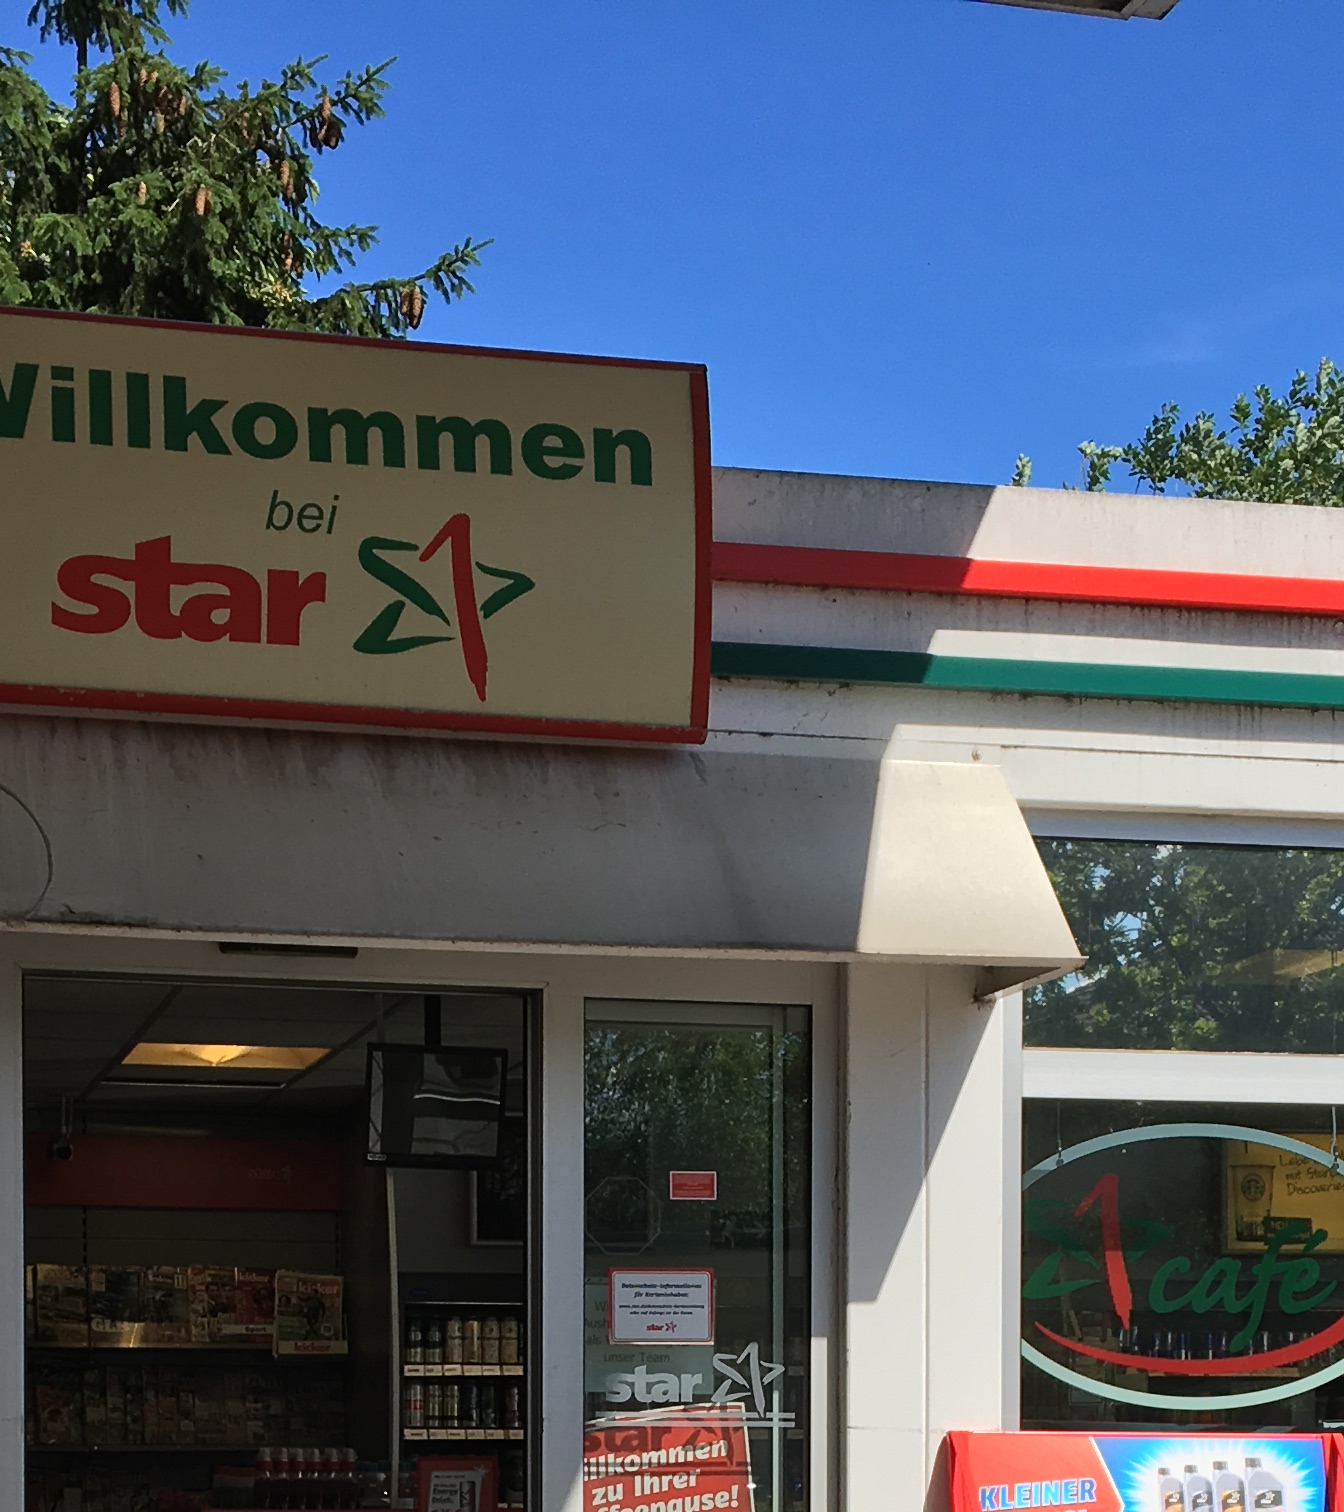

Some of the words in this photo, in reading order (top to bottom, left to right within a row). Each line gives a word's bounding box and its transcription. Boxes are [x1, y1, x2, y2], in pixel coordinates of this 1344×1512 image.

[265, 489, 341, 535] bei
[51, 535, 327, 646] star
[1148, 1224, 1337, 1353] café
[640, 1352, 671, 1363] Team
[605, 1364, 702, 1403] star
[583, 1439, 728, 1482] illkommen
[592, 1483, 624, 1506] zu
[634, 1468, 701, 1497] Ihrer
[979, 1477, 1097, 1512] KLEINER
